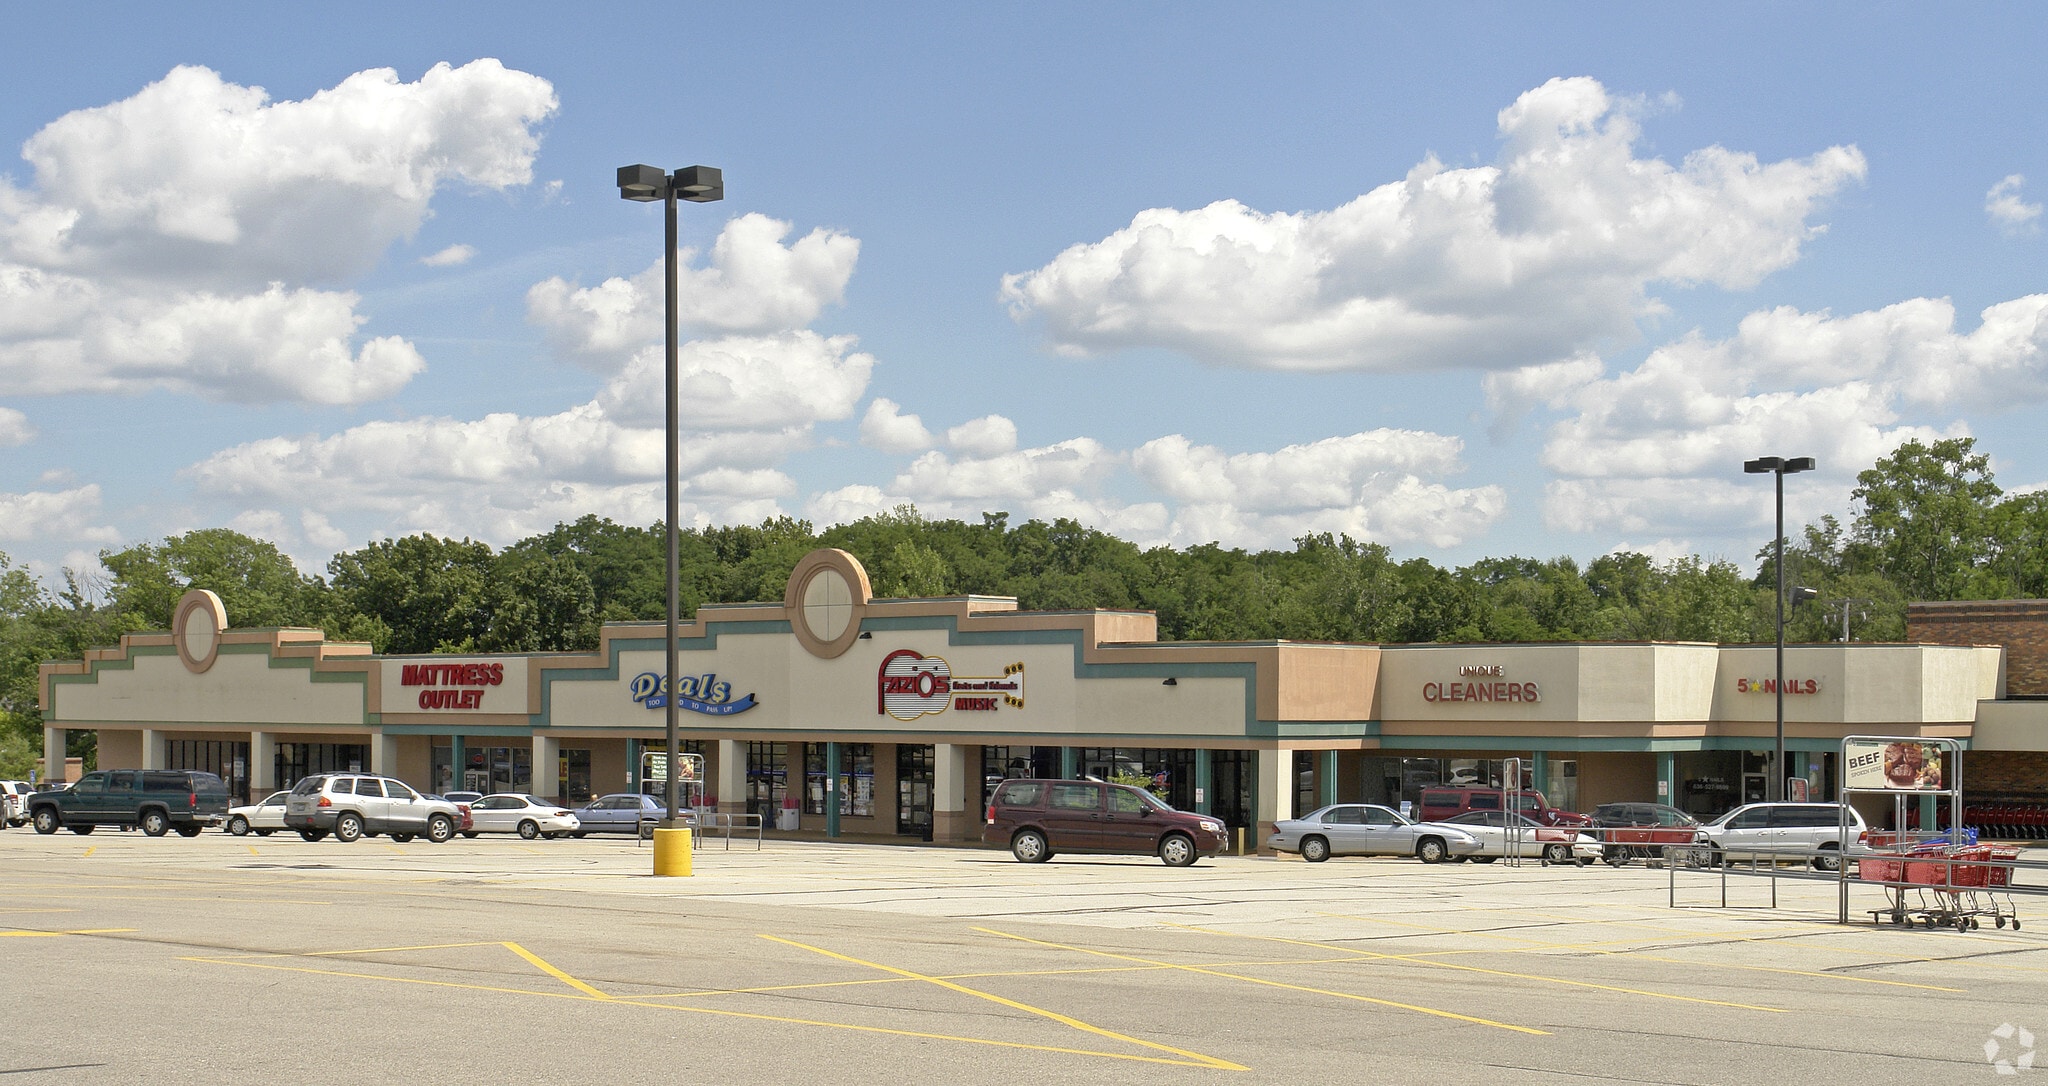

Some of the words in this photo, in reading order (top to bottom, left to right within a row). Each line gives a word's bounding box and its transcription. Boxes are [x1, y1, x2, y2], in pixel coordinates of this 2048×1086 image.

[401, 663, 504, 686] MATTRESS
[1459, 665, 1504, 677] UNIQUE
[1423, 682, 1539, 703] CLEANERS
[1737, 678, 1749, 693] 5
[418, 690, 485, 709] OUTLET
[954, 698, 998, 711] MUSIC
[1848, 752, 1880, 769] BEEF
